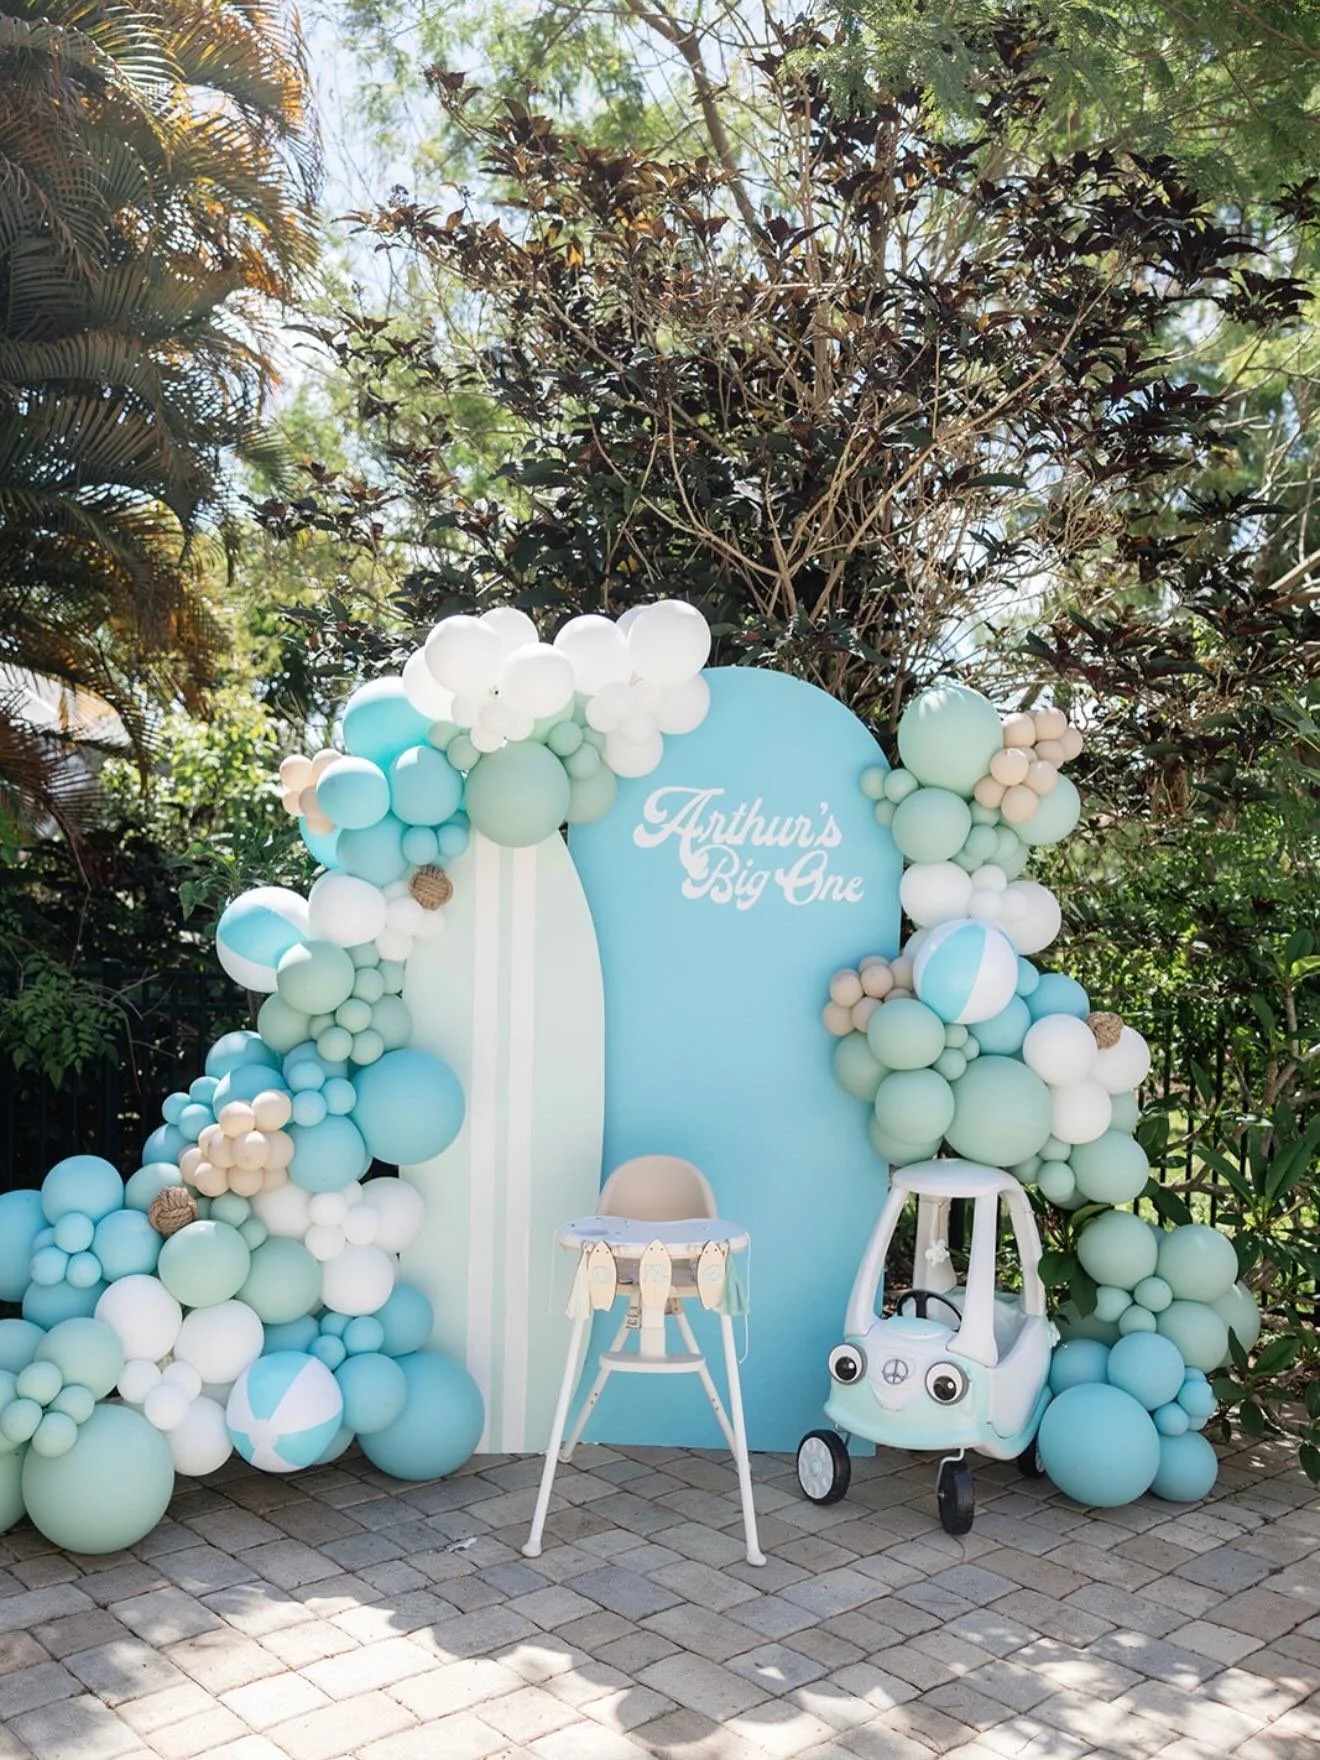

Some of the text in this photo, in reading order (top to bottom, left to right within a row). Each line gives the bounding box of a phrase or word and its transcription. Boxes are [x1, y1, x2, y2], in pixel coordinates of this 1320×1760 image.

[633, 786, 842, 879] Arthur's
[681, 844, 865, 910] Big One
